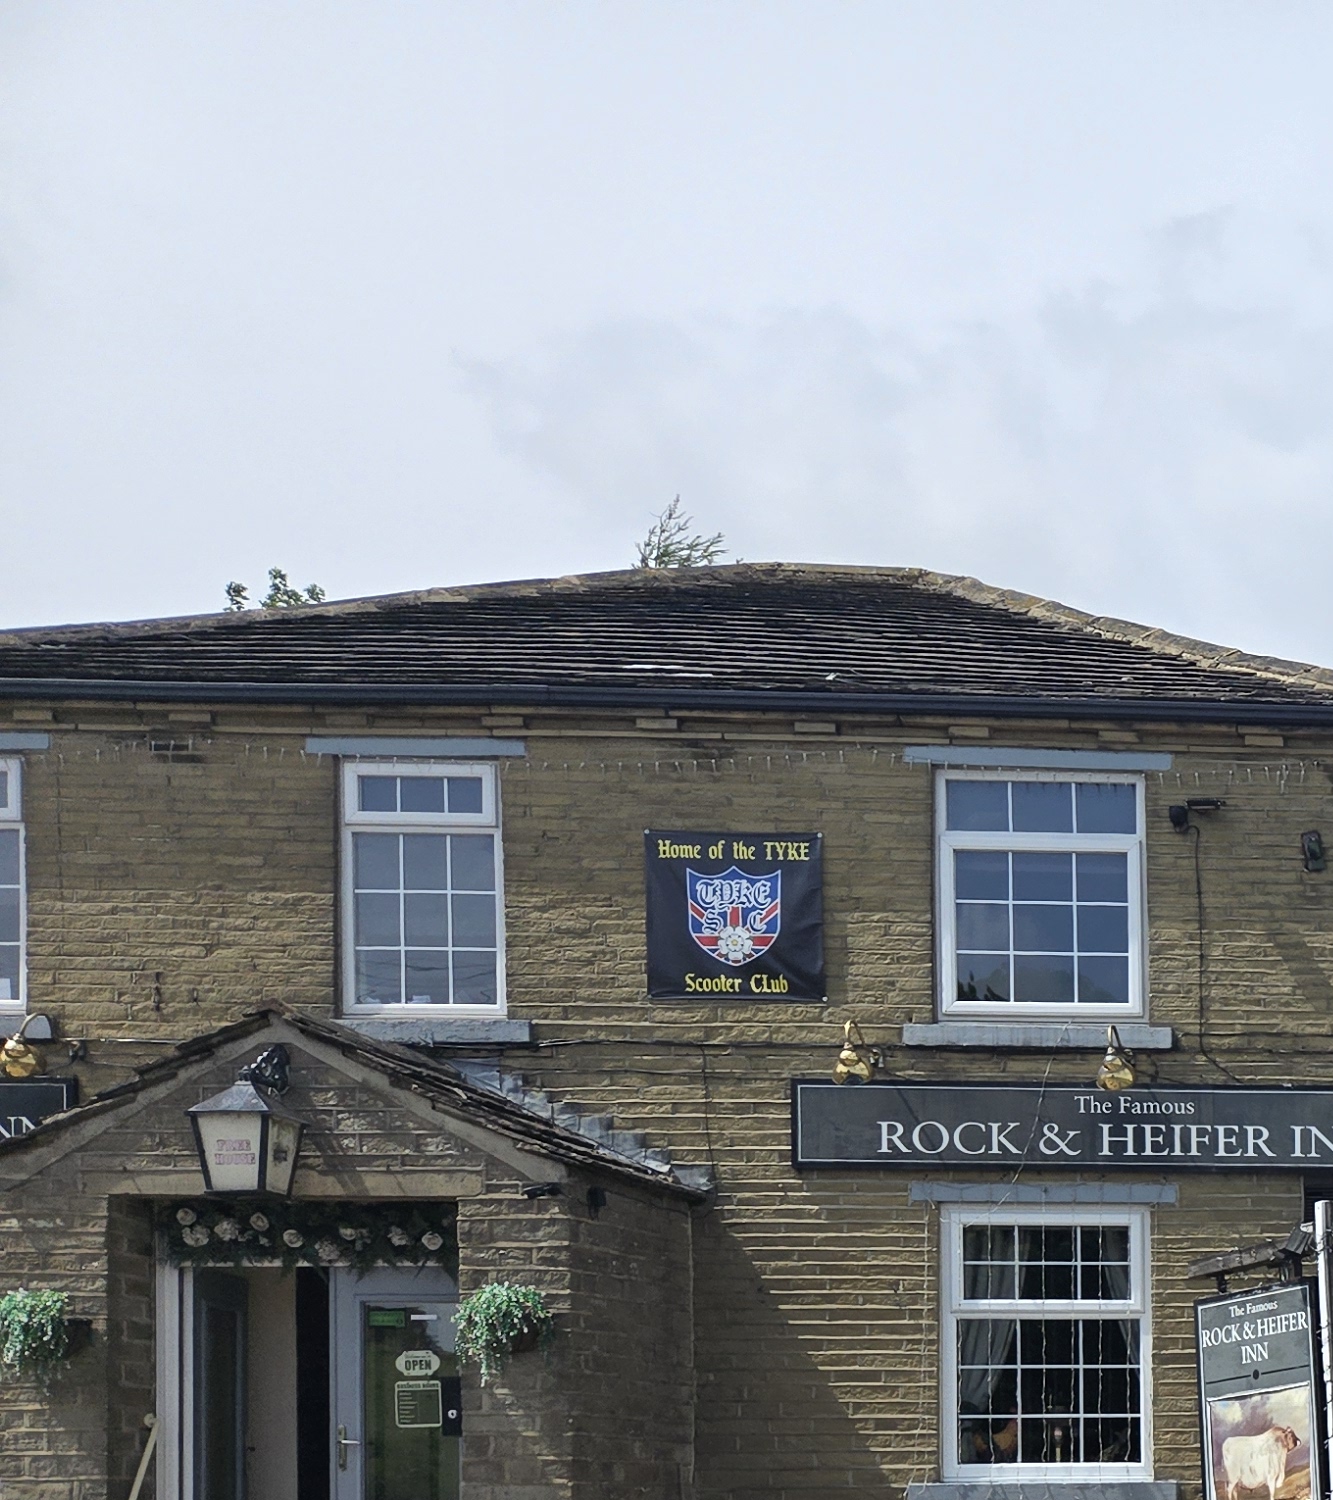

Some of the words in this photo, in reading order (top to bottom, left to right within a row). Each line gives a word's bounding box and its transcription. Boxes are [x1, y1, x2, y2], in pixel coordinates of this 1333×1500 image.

[658, 839, 701, 860] Home
[708, 840, 725, 860] of
[733, 840, 756, 860] the
[763, 841, 810, 861] TYKE
[684, 973, 742, 993] Scooter
[1073, 1095, 1112, 1114] The
[1118, 1096, 1195, 1115] Famous
[216, 1139, 251, 1151] FREE
[876, 1121, 1023, 1155] ROCK
[1038, 1122, 1082, 1156] &
[1097, 1123, 1277, 1157] HEIFER
[214, 1153, 256, 1165] HOUSE
[1229, 1304, 1245, 1318] The
[1246, 1300, 1278, 1315] Famous
[1201, 1323, 1242, 1348] ROCK
[1243, 1321, 1256, 1340] &
[1256, 1311, 1309, 1338] HEIFER
[1240, 1341, 1269, 1364] INN
[404, 1359, 432, 1371] OPEN
